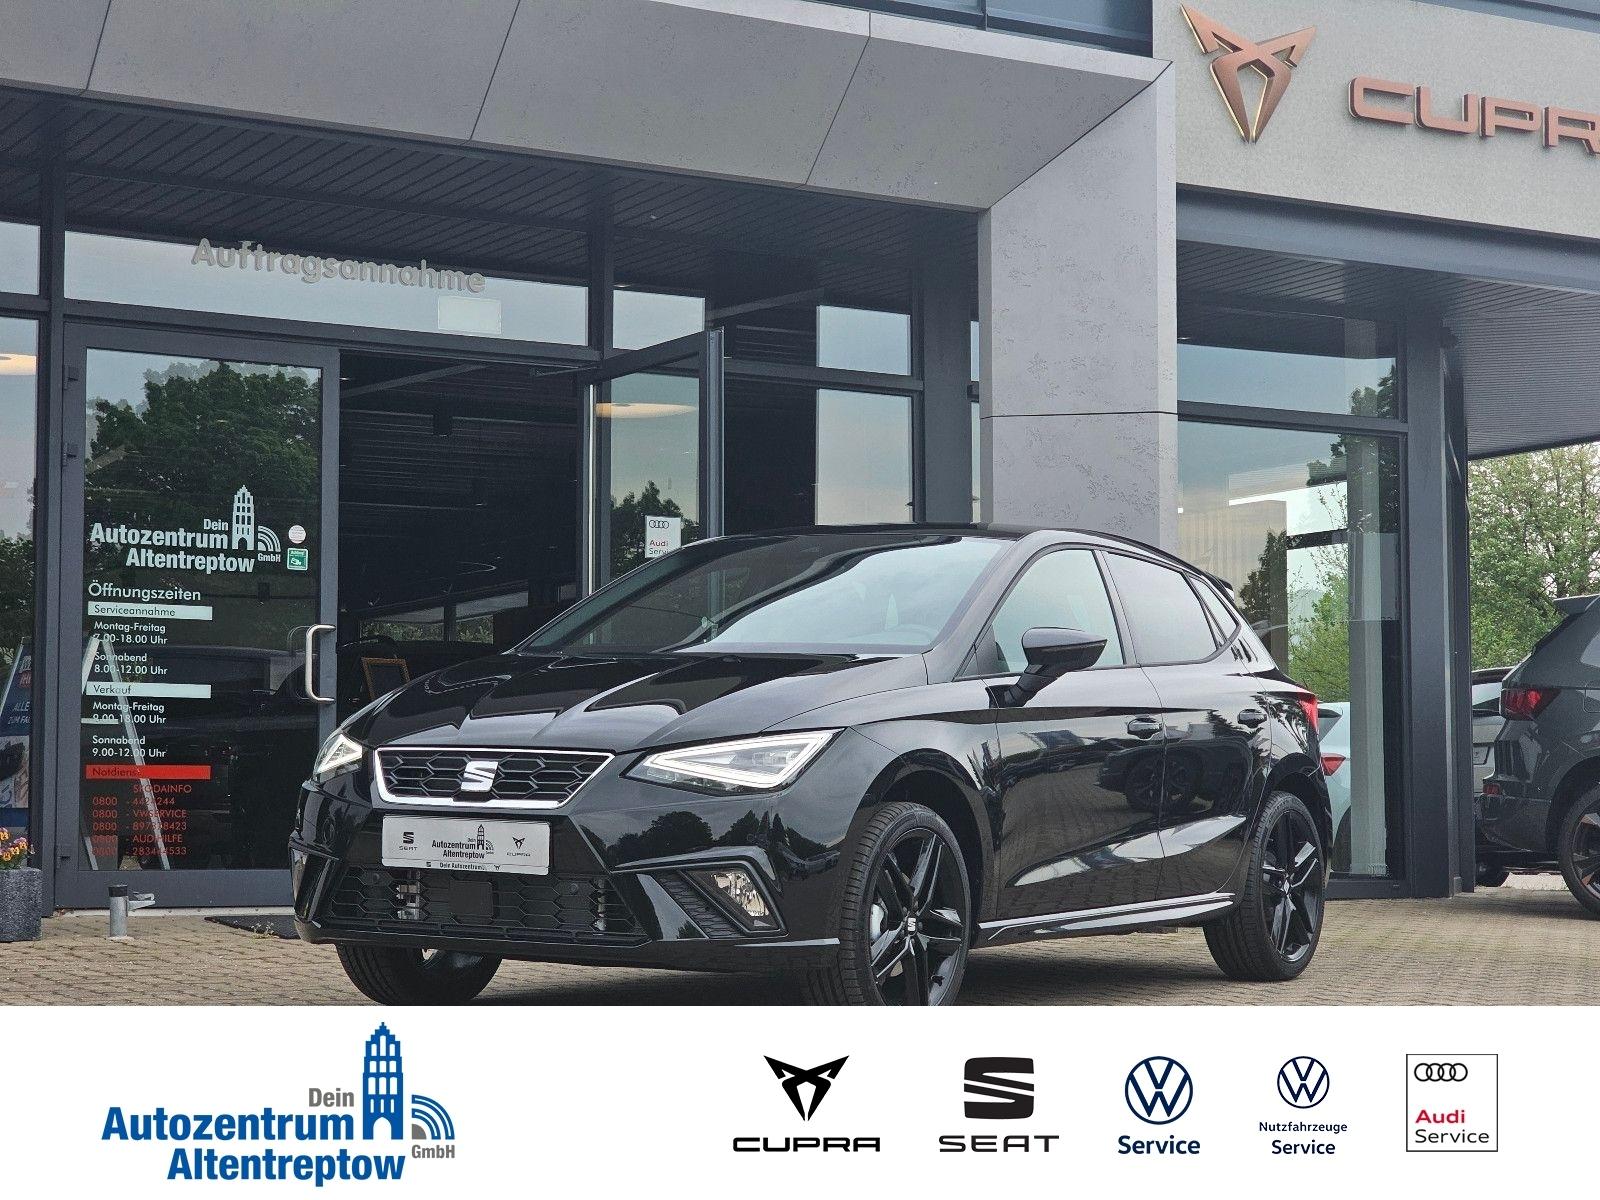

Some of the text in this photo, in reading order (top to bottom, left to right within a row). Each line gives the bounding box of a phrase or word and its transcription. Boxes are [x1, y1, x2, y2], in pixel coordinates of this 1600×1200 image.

[190, 237, 486, 293] Auftragsannahme
[203, 519, 229, 531] Dein
[89, 523, 228, 549] Autozentrum
[126, 548, 255, 574] Altentreptow
[257, 553, 281, 563] GmbH
[88, 580, 201, 601] Öffnungszeiten
[94, 604, 176, 617] Serviceannahme
[93, 621, 166, 634] Montag-Freitag
[150, 634, 168, 645] Uhr
[150, 665, 168, 675] Uhr
[93, 684, 131, 695] Verkauf
[92, 701, 165, 713] Montag-Freitag
[149, 714, 167, 724] Uhr
[92, 735, 146, 745] Sonnabend
[148, 748, 166, 758] Uhr
[431, 839, 476, 850] Autozentrum
[443, 849, 485, 859] Altentreptow
